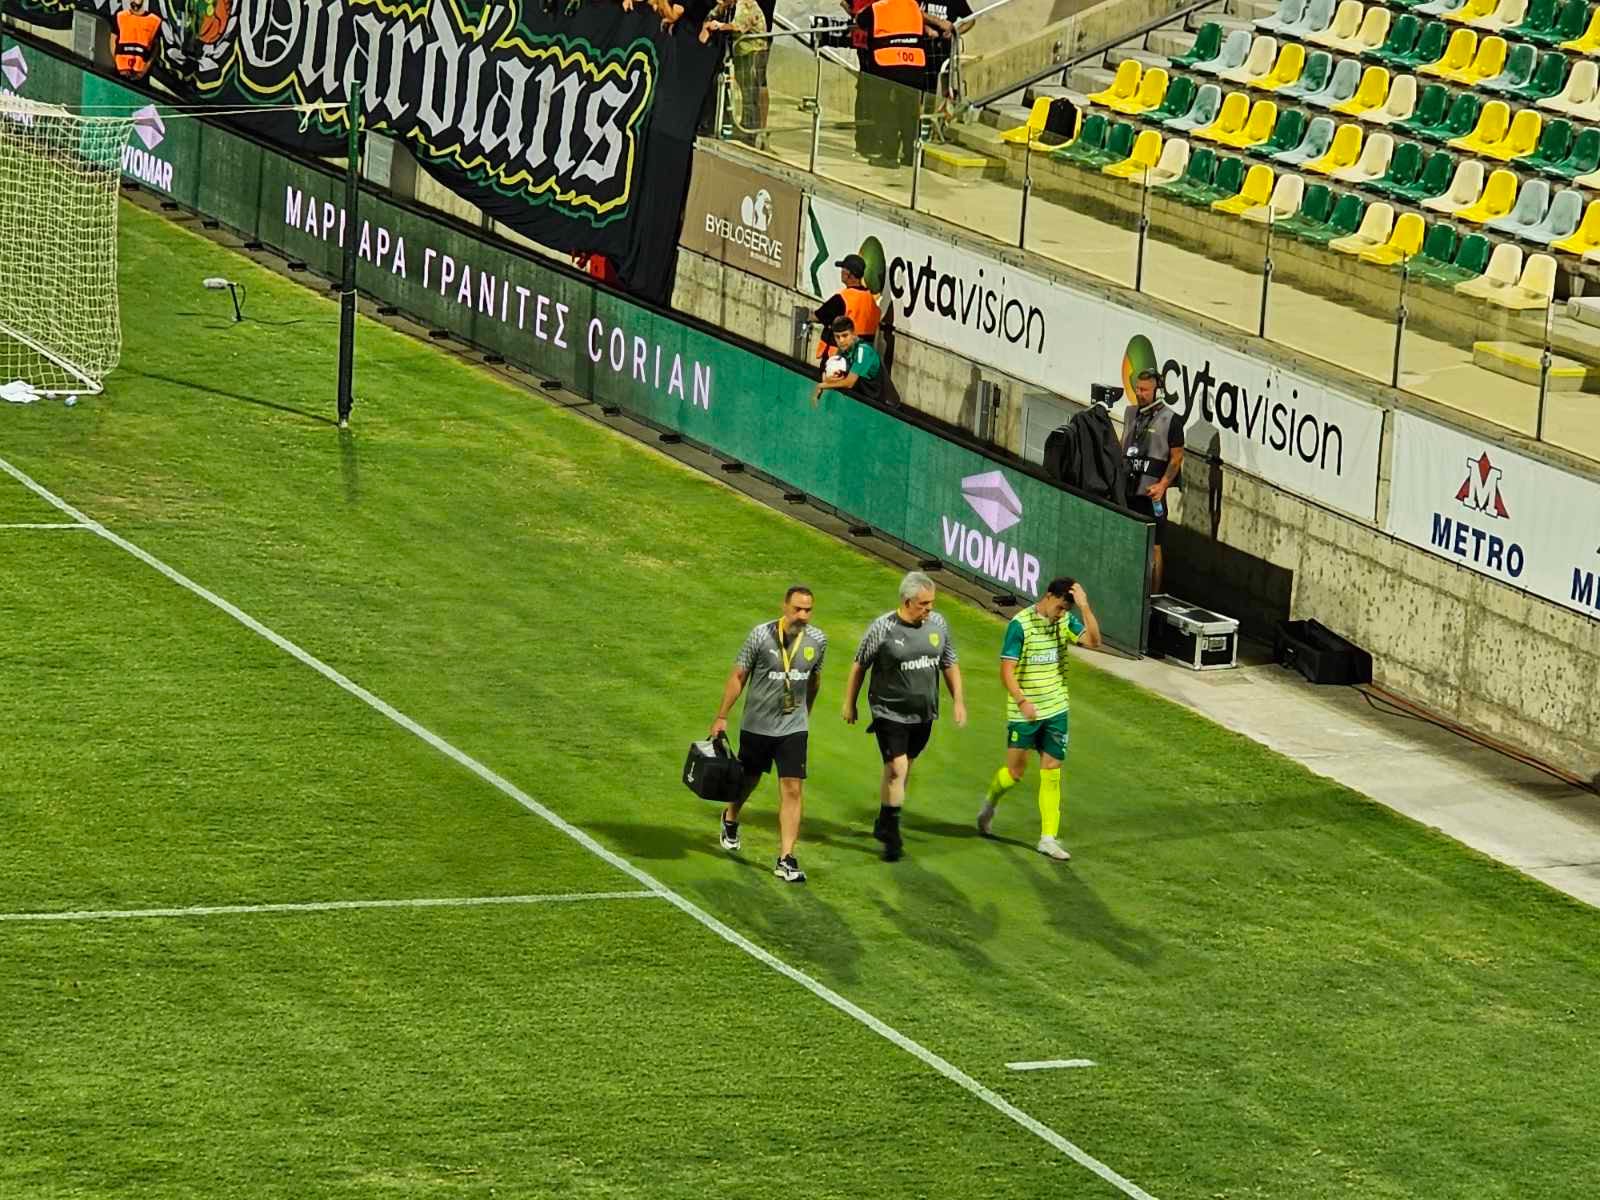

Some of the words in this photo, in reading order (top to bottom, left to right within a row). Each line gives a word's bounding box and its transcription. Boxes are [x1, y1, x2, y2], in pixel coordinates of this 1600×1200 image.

[121, 142, 173, 193] VIOMAR
[705, 213, 783, 260] BYBLOSERVE
[423, 248, 570, 349] ΓΡΑΝΙΤΕΣ
[587, 318, 712, 410] CORIAN
[888, 255, 1046, 354] cytavision
[1160, 358, 1344, 476] cytavision
[942, 515, 1041, 597] VIOMAR
[1431, 512, 1524, 578] METRO
